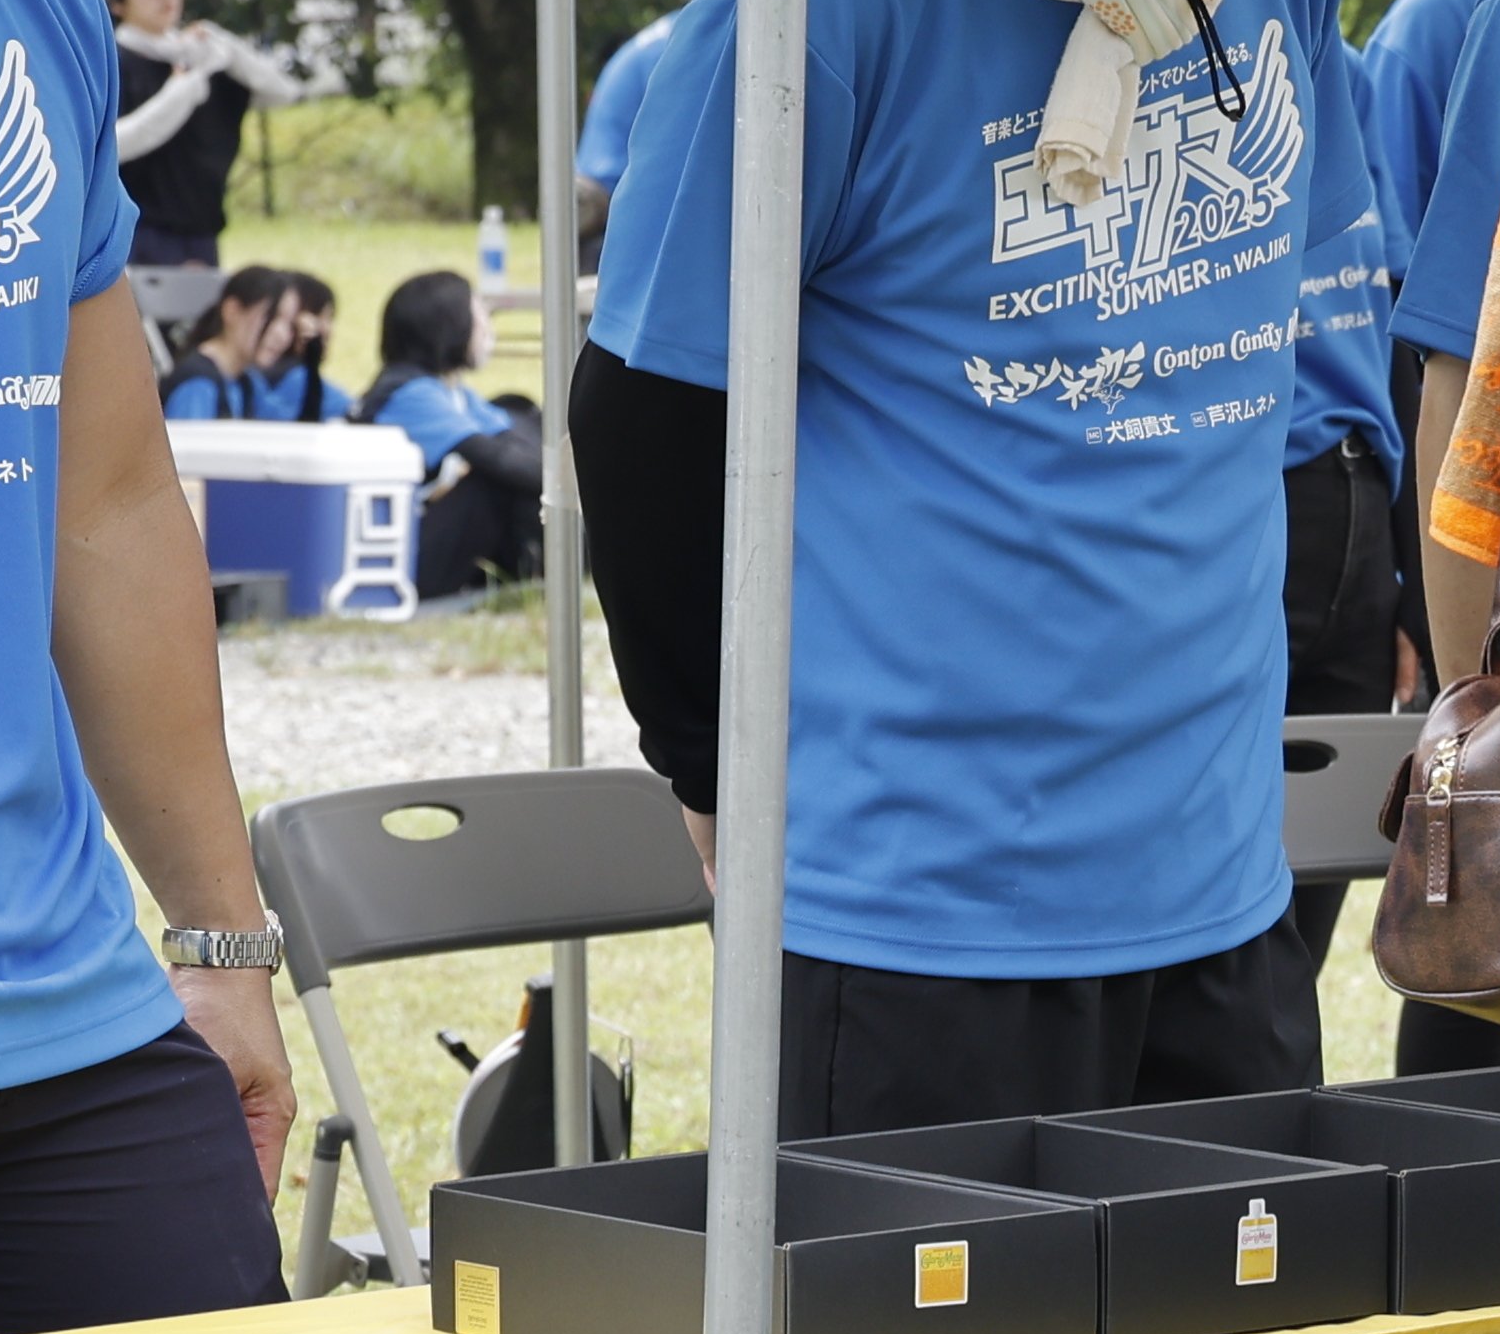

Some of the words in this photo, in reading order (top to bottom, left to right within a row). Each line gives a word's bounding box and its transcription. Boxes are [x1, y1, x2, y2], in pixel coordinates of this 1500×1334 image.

[1171, 177, 1274, 256] 2025
[988, 260, 1129, 322] EXCITING
[1097, 259, 1210, 322] SUMMER
[1214, 261, 1232, 280] in
[1234, 233, 1291, 269] WAJIKI
[1153, 341, 1226, 377] Conton
[1230, 324, 1284, 363] Candy
[1105, 413, 1179, 444] 犬飼貴丈
[1206, 392, 1277, 429] 芦沢ムネト
